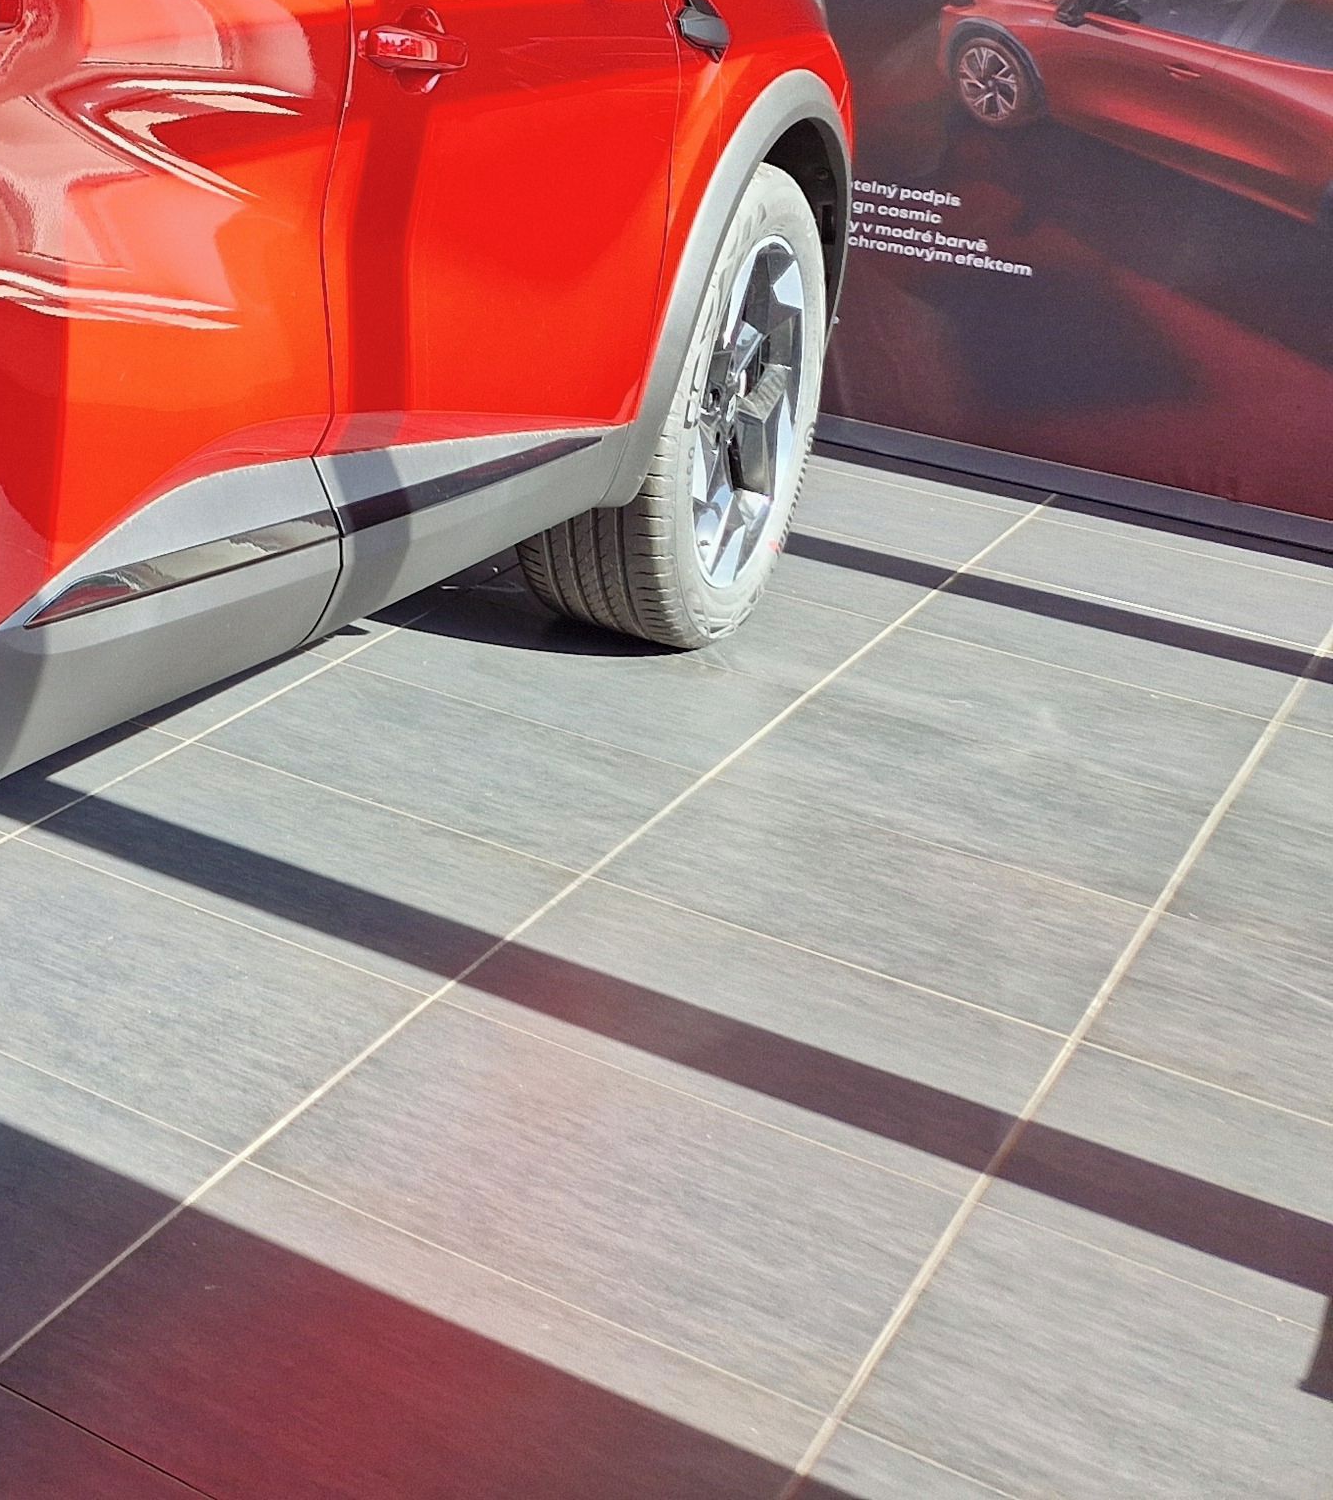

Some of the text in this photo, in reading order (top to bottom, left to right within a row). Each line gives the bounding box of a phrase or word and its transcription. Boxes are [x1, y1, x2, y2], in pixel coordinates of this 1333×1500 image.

[851, 179, 961, 207] telný podpis
[877, 206, 942, 224] cosmic
[862, 222, 873, 233] v
[875, 223, 933, 243] modré
[935, 232, 988, 252] barvě
[847, 236, 1033, 277] chromovým efektem
